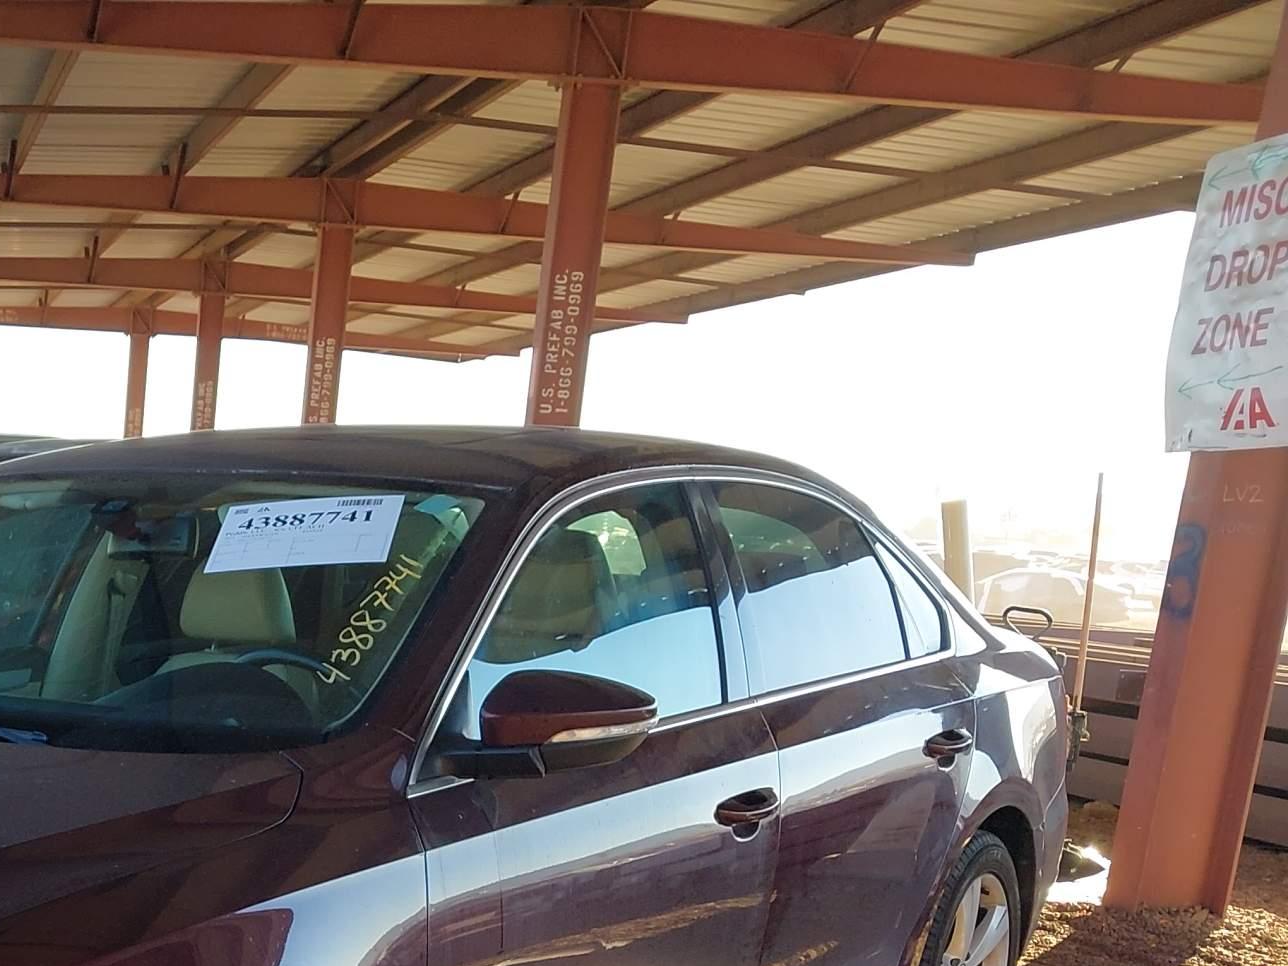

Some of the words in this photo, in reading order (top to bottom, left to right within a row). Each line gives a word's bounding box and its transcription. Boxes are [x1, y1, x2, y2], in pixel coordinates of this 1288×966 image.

[553, 269, 569, 301] INC.
[1204, 240, 1288, 292] DROP
[544, 310, 563, 373] PREFAB
[555, 271, 584, 413] 1-866-799-0969
[1191, 307, 1274, 355] ZONE
[539, 383, 555, 414] U.S.
[238, 509, 374, 531] 43887741
[316, 553, 424, 684] 43887741
